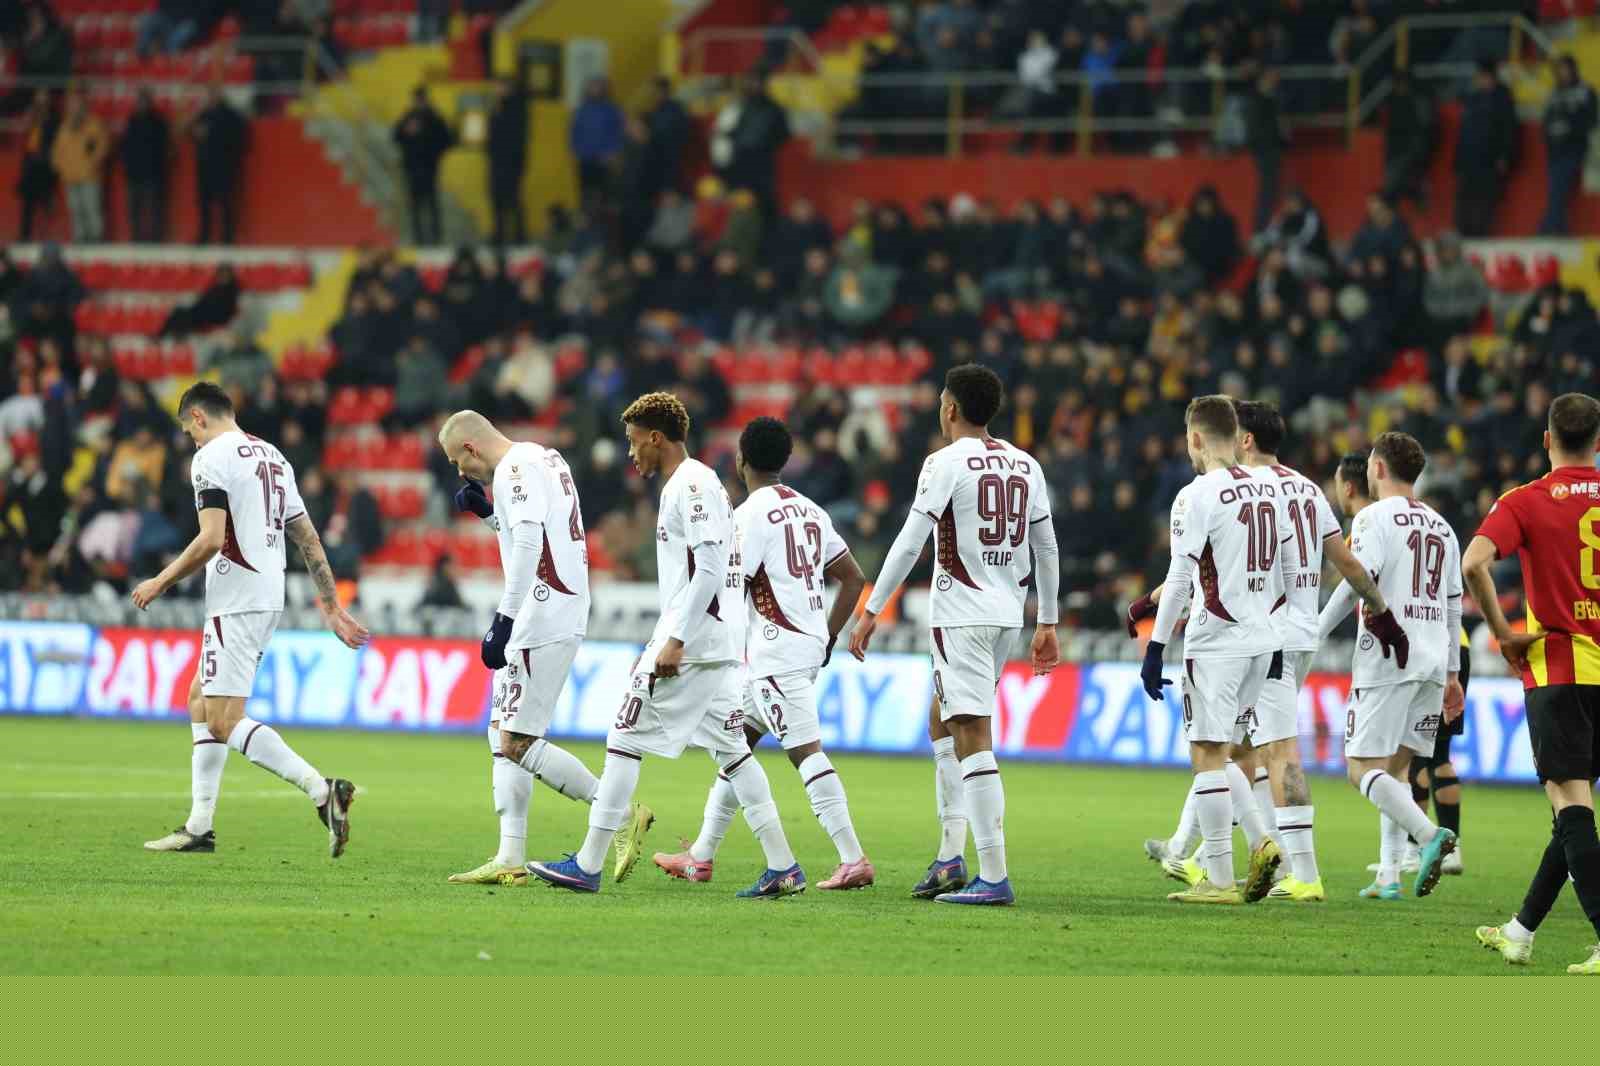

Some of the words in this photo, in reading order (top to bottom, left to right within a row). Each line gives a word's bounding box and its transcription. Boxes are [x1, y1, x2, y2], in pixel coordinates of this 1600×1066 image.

[967, 455, 1031, 475] onvo
[1280, 481, 1318, 497] nvo
[1570, 482, 1600, 495] ME
[255, 460, 287, 530] 15
[559, 471, 585, 542] 2
[977, 473, 1029, 548] 99
[1219, 483, 1276, 504] onvo
[784, 521, 823, 591] 42
[1237, 501, 1278, 572] 10
[1287, 499, 1318, 568] 11
[981, 551, 1013, 567] FELIP
[1406, 529, 1446, 601] 19
[1404, 604, 1444, 623] MUSTAF
[1346, 709, 1356, 738] 9
